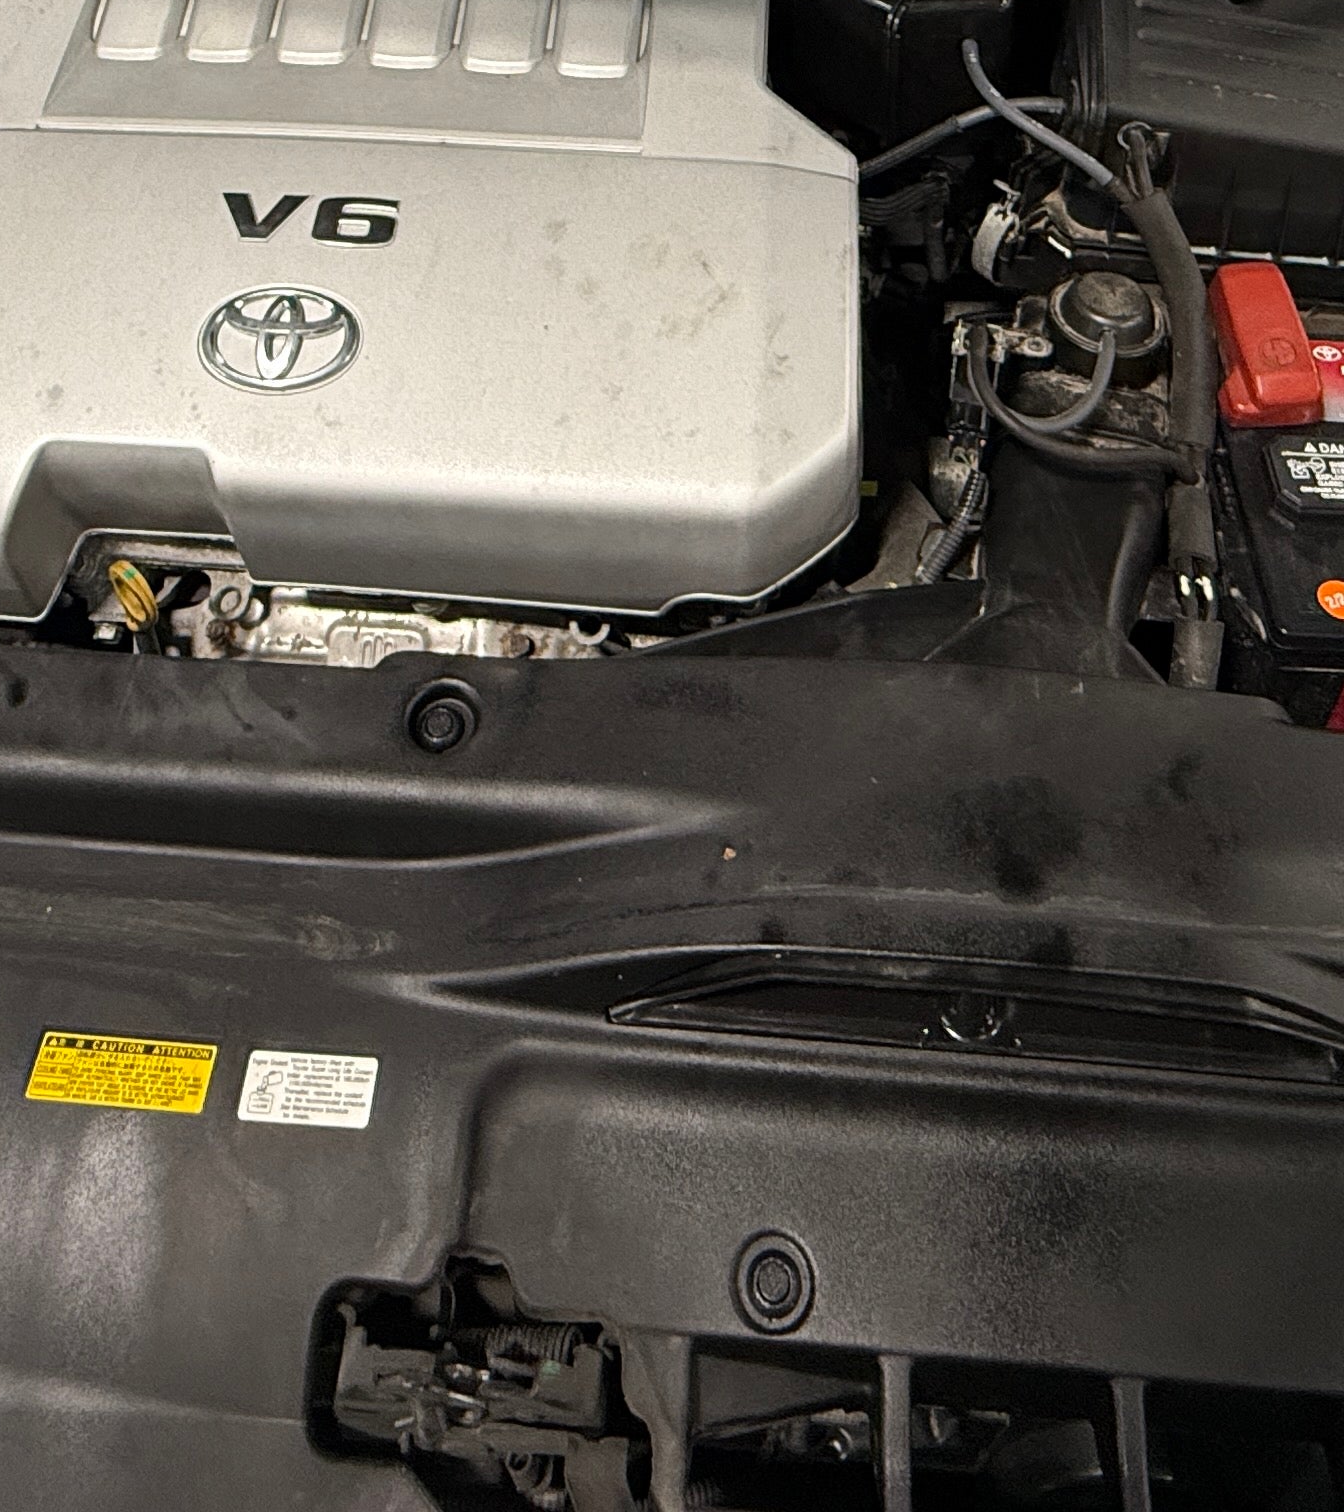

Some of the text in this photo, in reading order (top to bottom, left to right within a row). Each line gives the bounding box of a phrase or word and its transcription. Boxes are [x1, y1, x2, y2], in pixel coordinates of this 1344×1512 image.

[222, 192, 401, 248] V6
[92, 1039, 145, 1053] CAUTION
[151, 1046, 211, 1058] ATTENTION
